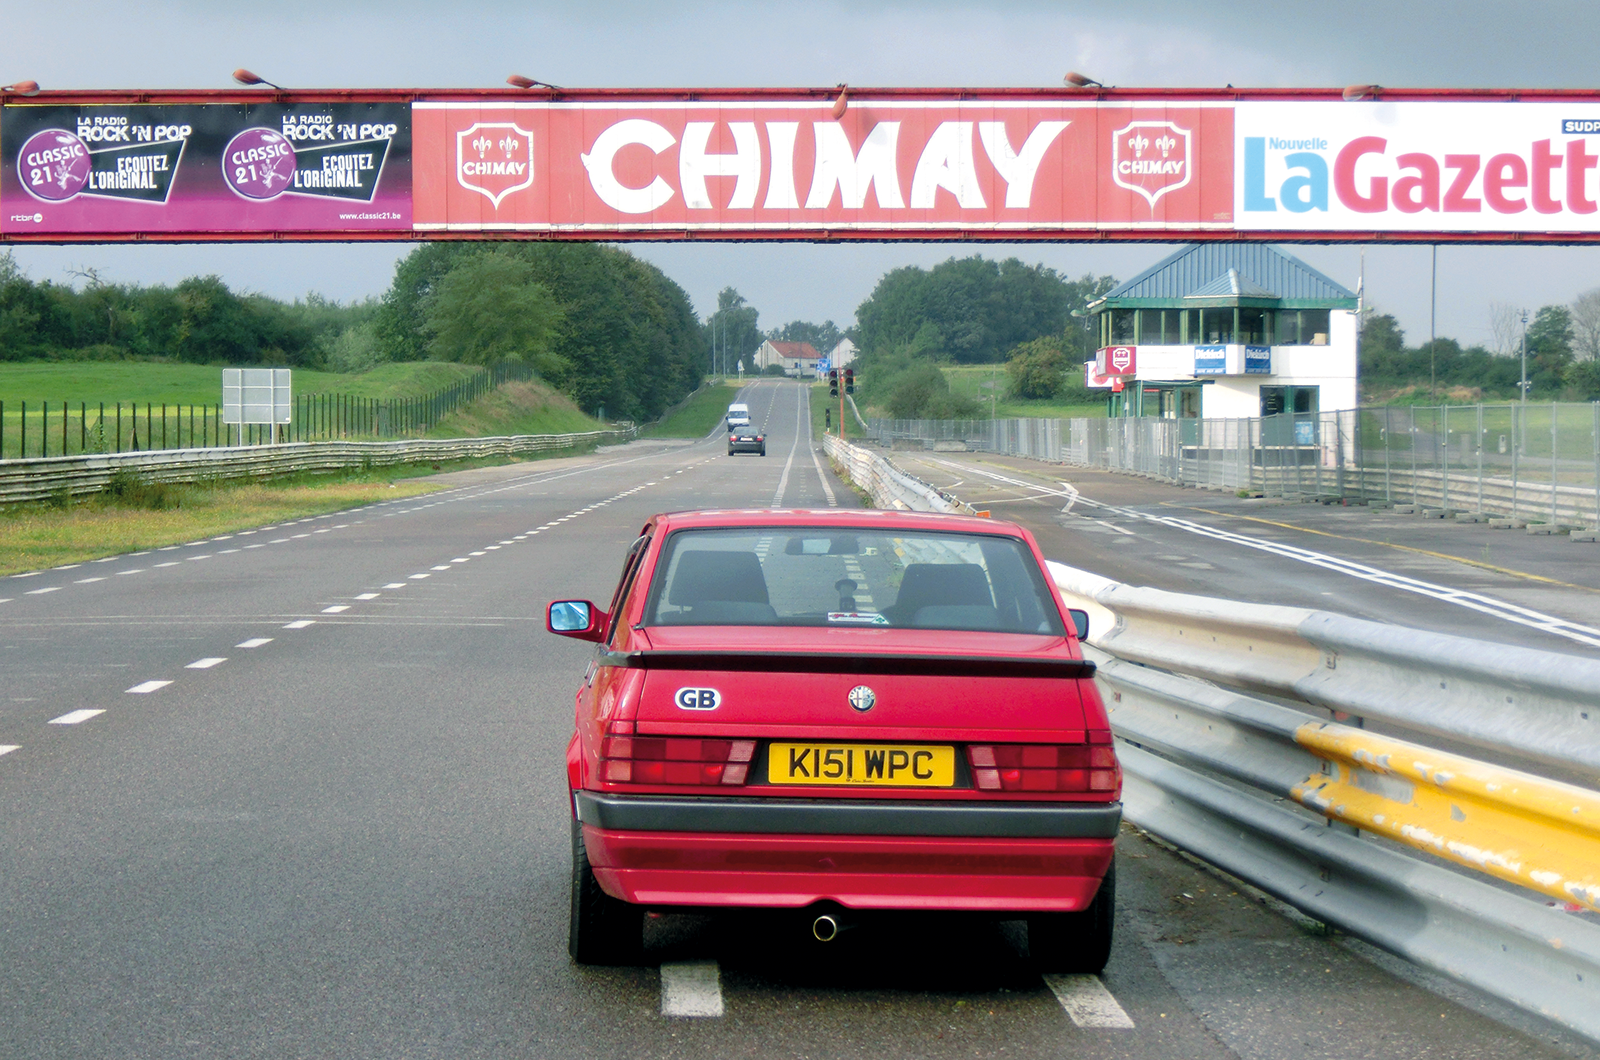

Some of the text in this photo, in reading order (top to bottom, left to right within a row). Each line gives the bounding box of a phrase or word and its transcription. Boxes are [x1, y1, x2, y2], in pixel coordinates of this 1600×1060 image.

[77, 117, 128, 126] LA RADIO
[282, 115, 333, 124] LA RADIO
[77, 126, 130, 142] ROCK
[154, 125, 192, 142] POP
[282, 124, 335, 141] ROCK
[360, 123, 398, 141] POP
[1268, 136, 1328, 150] Nouvelle
[27, 144, 84, 167] CLASSIC
[117, 154, 169, 173] ECOUTEZ
[232, 143, 289, 165] CLASSIC
[322, 153, 374, 172] ECOUTEZ
[30, 165, 52, 186] 21
[235, 164, 257, 185] 21
[462, 161, 527, 176] CHIMAY
[580, 118, 1072, 214] CHIMAY
[1118, 159, 1185, 175] CHIMAY
[1243, 135, 1600, 215] La Gazett
[339, 212, 402, 220] www.classic21.be
[678, 688, 716, 709] GB
[789, 747, 934, 780] K151 WPC
